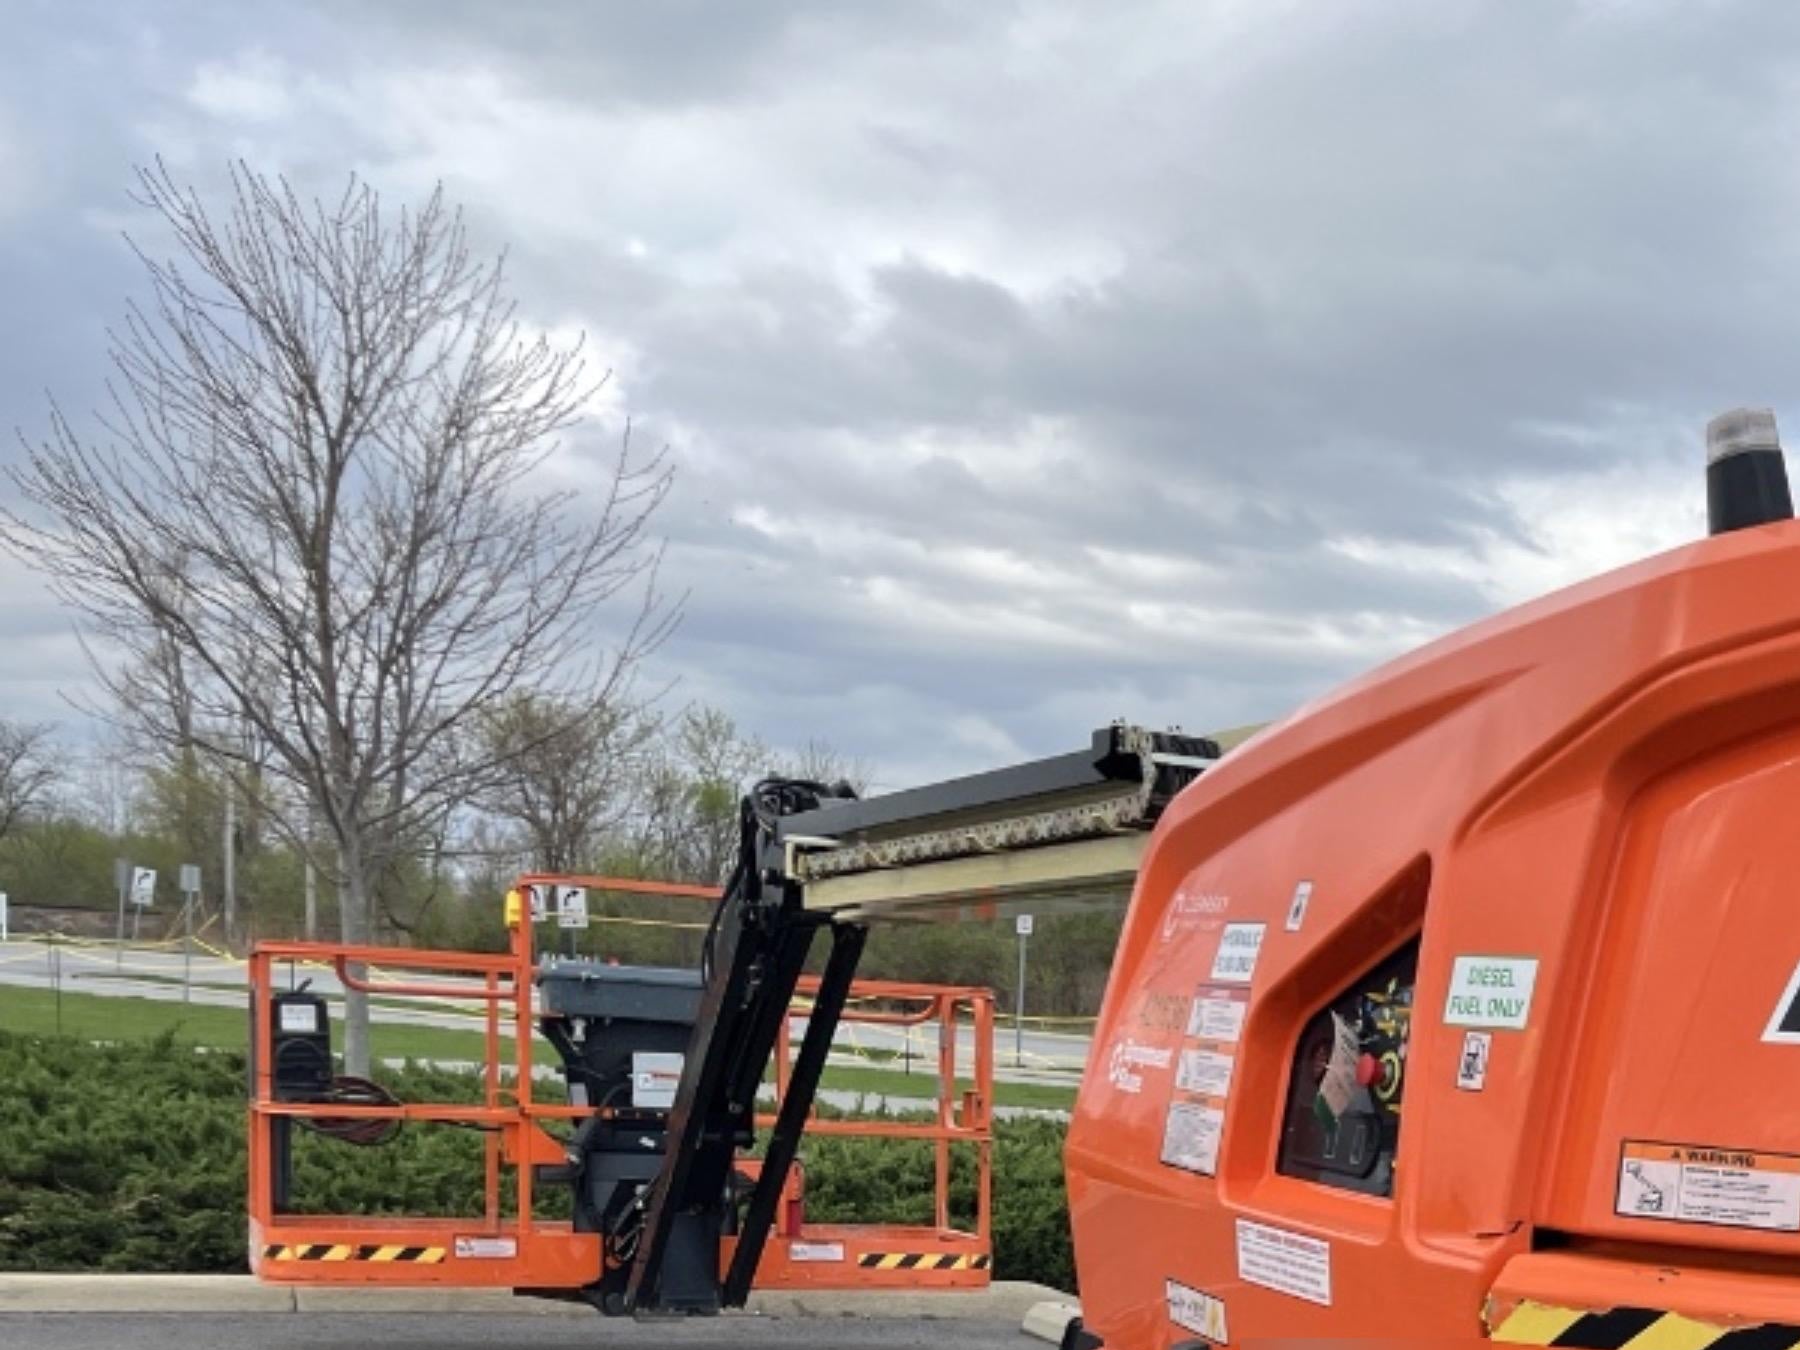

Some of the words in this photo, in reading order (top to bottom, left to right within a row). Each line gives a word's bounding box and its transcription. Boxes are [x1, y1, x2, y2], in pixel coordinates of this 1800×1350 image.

[1467, 966, 1515, 988] DIESEL
[1449, 995, 1482, 1015] FUEL
[1487, 998, 1525, 1018] ONLY
